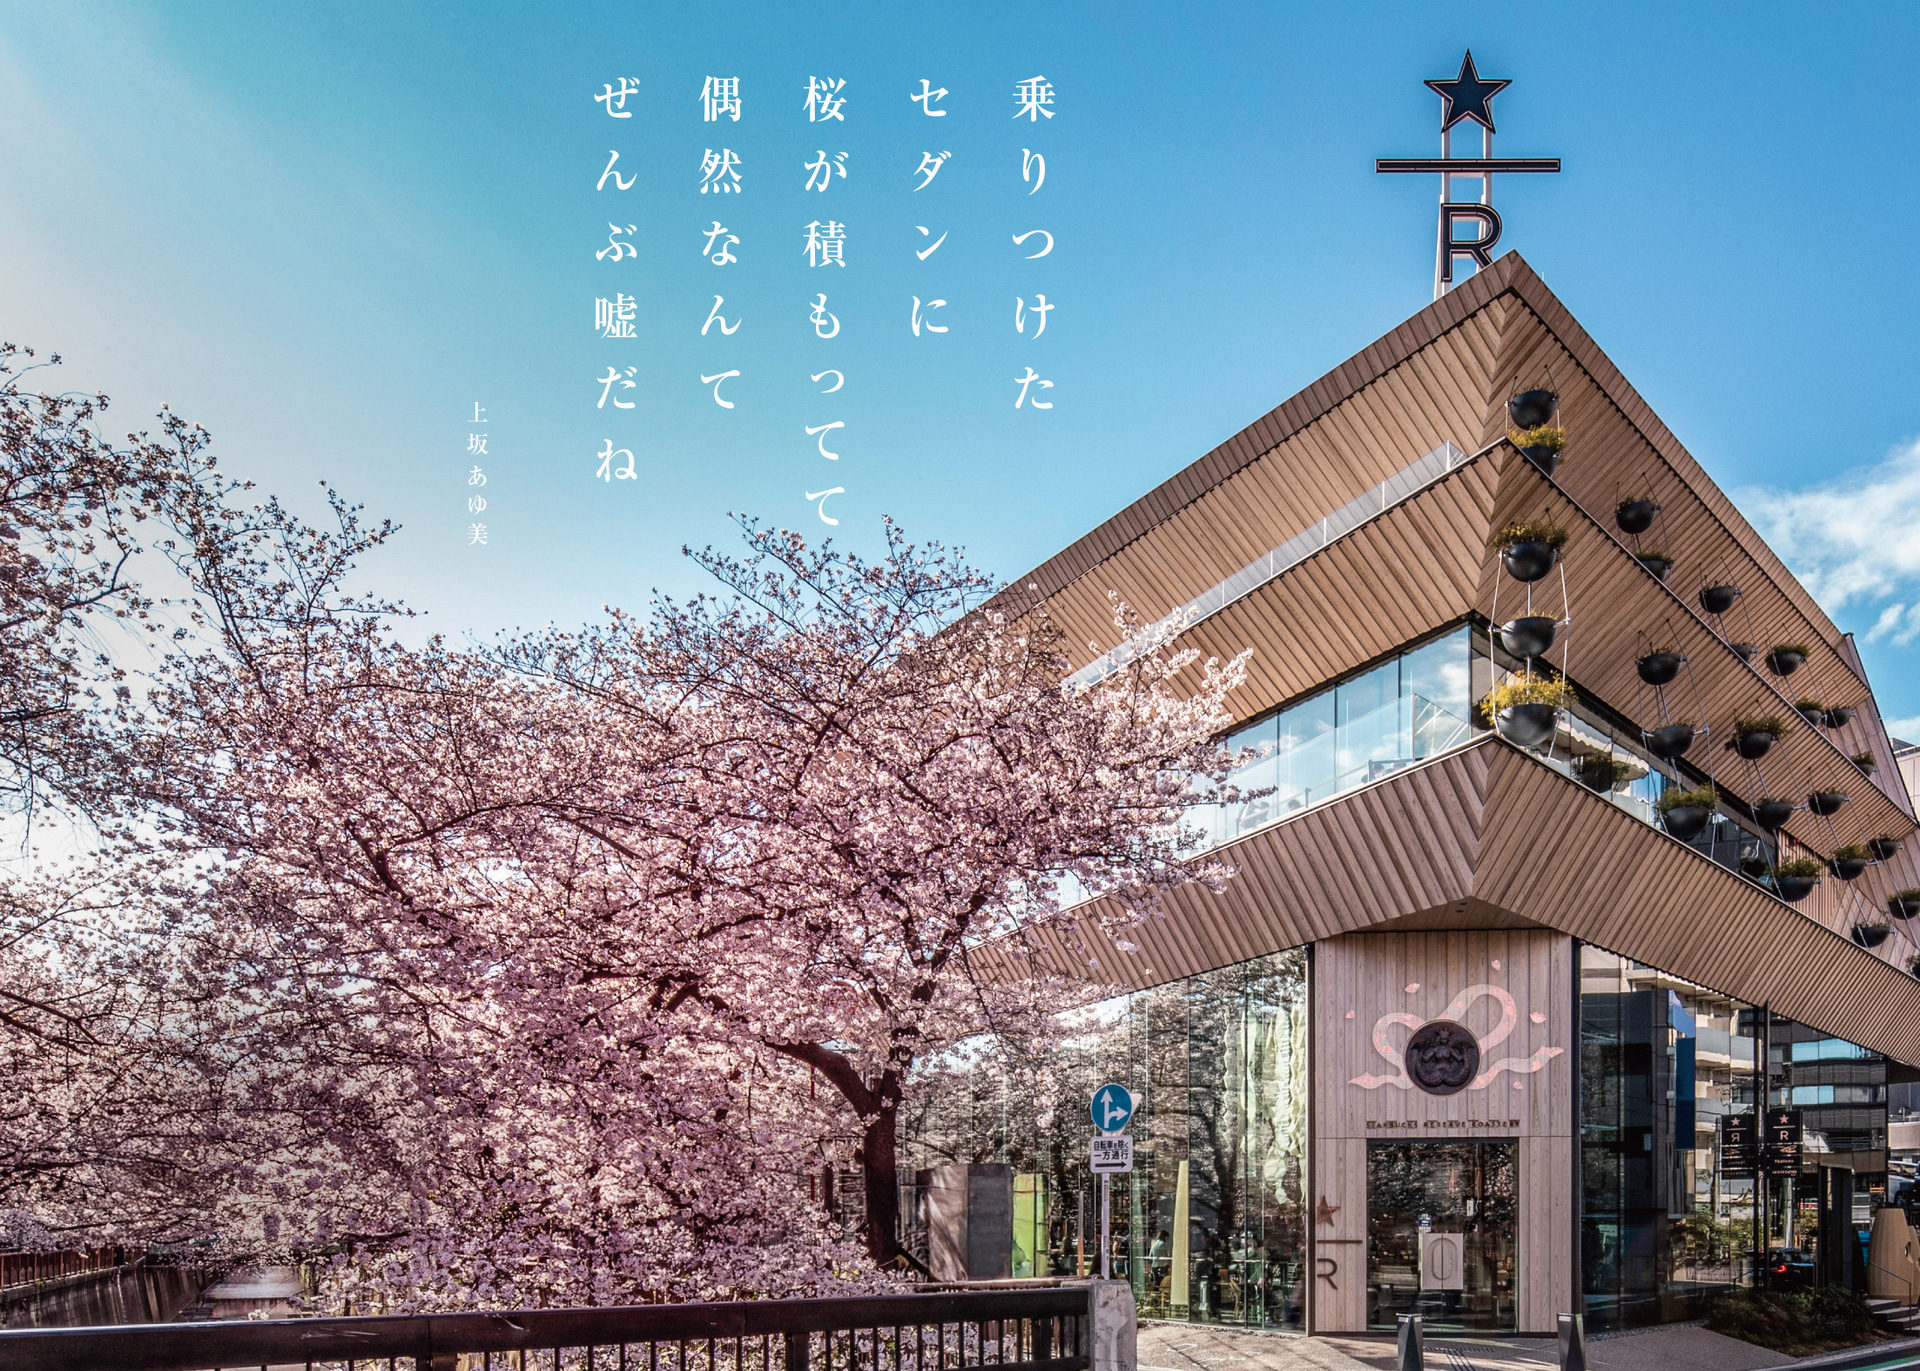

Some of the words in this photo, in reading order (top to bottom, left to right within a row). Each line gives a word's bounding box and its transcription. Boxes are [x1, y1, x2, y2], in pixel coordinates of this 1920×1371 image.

[1440, 203, 1502, 282] R
[1366, 1121, 1418, 1129] STARBUCKS
[1423, 1120, 1466, 1128] RESERVE
[1471, 1120, 1520, 1128] ROASTERY
[1780, 1130, 1789, 1140] R
[1093, 1140, 1129, 1150] 自転車を除く
[1093, 1150, 1129, 1160] 一方通行
